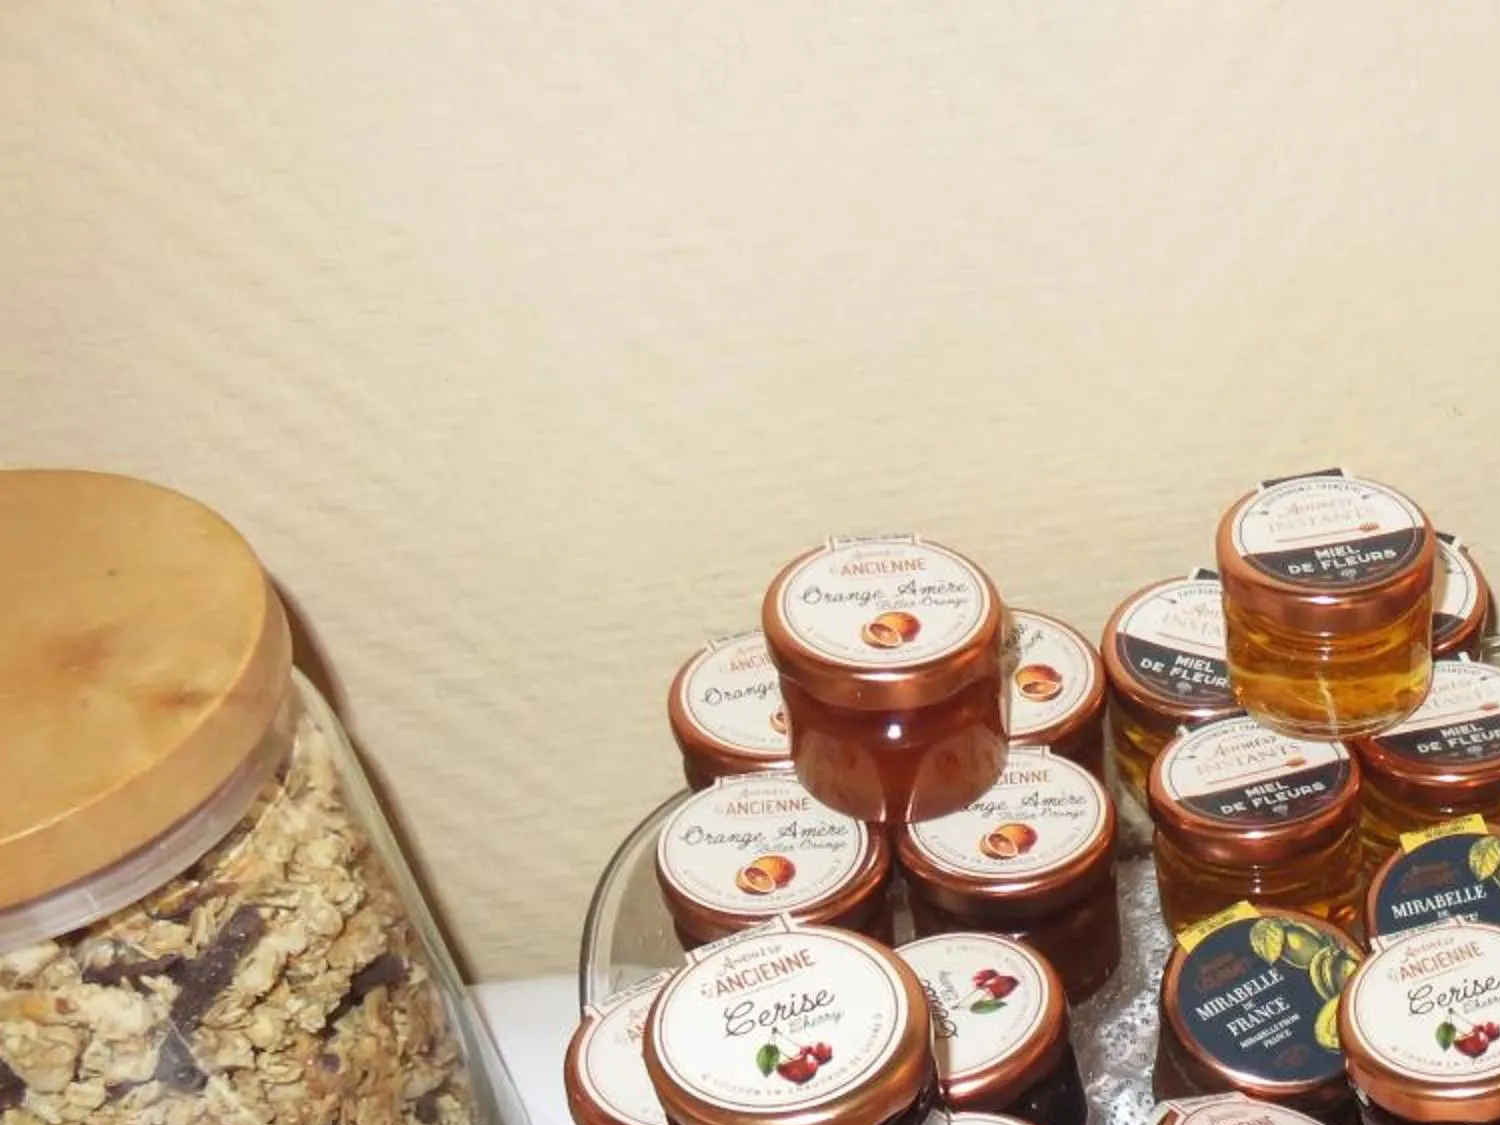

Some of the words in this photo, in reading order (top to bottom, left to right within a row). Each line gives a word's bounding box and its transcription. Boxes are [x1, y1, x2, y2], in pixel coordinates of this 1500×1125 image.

[1287, 563, 1315, 575] DE
[1320, 549, 1397, 571] FLEURS
[1314, 545, 1360, 561] MIEL
[840, 557, 928, 577] ANCIENNE
[797, 585, 885, 609] Orange
[897, 578, 971, 598] Amère
[729, 653, 772, 673] ANCI
[1140, 658, 1165, 672] DE
[1175, 655, 1215, 674] MIEL
[701, 680, 778, 706] Orange
[1440, 723, 1484, 738] MIEL
[1417, 741, 1442, 753] DE
[999, 769, 1053, 786] IENNE
[1220, 803, 1247, 815] DE
[1253, 781, 1327, 808] FLEURS
[1245, 780, 1290, 799] MIEL
[724, 797, 812, 817] ANCIENNE
[680, 825, 767, 851] Orange
[777, 820, 849, 838] Amère
[1391, 883, 1488, 920] MIRABELLE
[1400, 941, 1485, 982] ANCIENNE
[714, 948, 818, 1000] ANCIENNE
[1194, 966, 1285, 1022] MIRABELLE
[722, 987, 837, 1038] Cerise
[1225, 996, 1291, 1037] FRANCE
[1262, 1029, 1294, 1048] FRANCE
